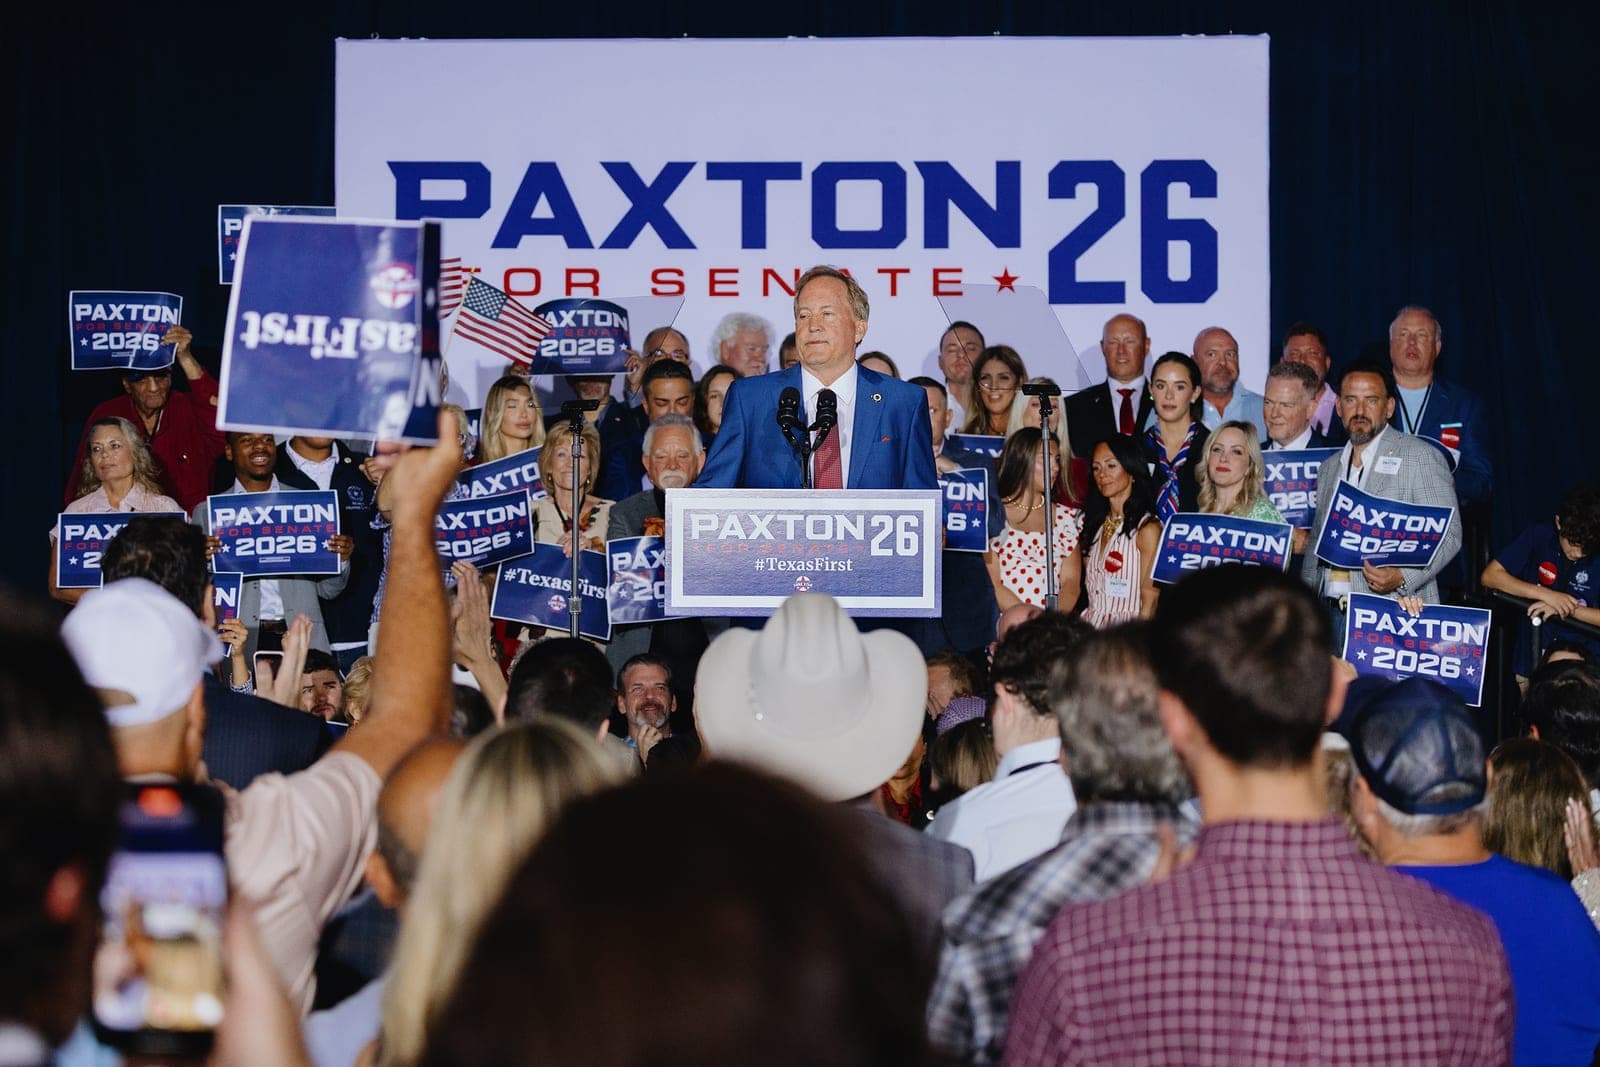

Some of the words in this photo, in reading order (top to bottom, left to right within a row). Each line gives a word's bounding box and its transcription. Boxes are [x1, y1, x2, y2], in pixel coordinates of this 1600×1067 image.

[387, 160, 1021, 249] PAXTON
[1048, 159, 1218, 304] 26
[462, 267, 599, 297] OR
[651, 268, 963, 297] SENTE
[75, 304, 178, 324] PAXTON
[539, 309, 627, 331] AXTON
[114, 323, 167, 331] SENAT
[240, 310, 417, 360] asFirst
[92, 332, 160, 351] 2026
[541, 338, 615, 357] 2026
[462, 462, 540, 498] AXTO
[1264, 461, 1321, 481] XTO
[214, 504, 334, 526] PAXTON
[435, 501, 527, 530] AXTON
[1335, 493, 1446, 533] PAXTON
[64, 524, 128, 541] PAX
[215, 528, 252, 537] FOR
[262, 524, 336, 535] SENATE
[691, 514, 865, 540] PAXTON
[870, 514, 919, 557] 26
[1168, 523, 1286, 555] PAXTON
[64, 541, 101, 550] FOR
[235, 535, 317, 556] 2026
[436, 531, 511, 557] 2026
[706, 543, 750, 554] FOR
[761, 543, 849, 555] SENATE
[1167, 541, 1201, 552] FOR
[1210, 547, 1283, 564] SENATE
[1340, 530, 1419, 554] 2026
[755, 557, 853, 571] #TexasFirst
[503, 567, 608, 600] #Texasirs
[1354, 607, 1485, 646] PAXTON
[1353, 630, 1394, 646] FOR
[1372, 646, 1461, 679] 2026
